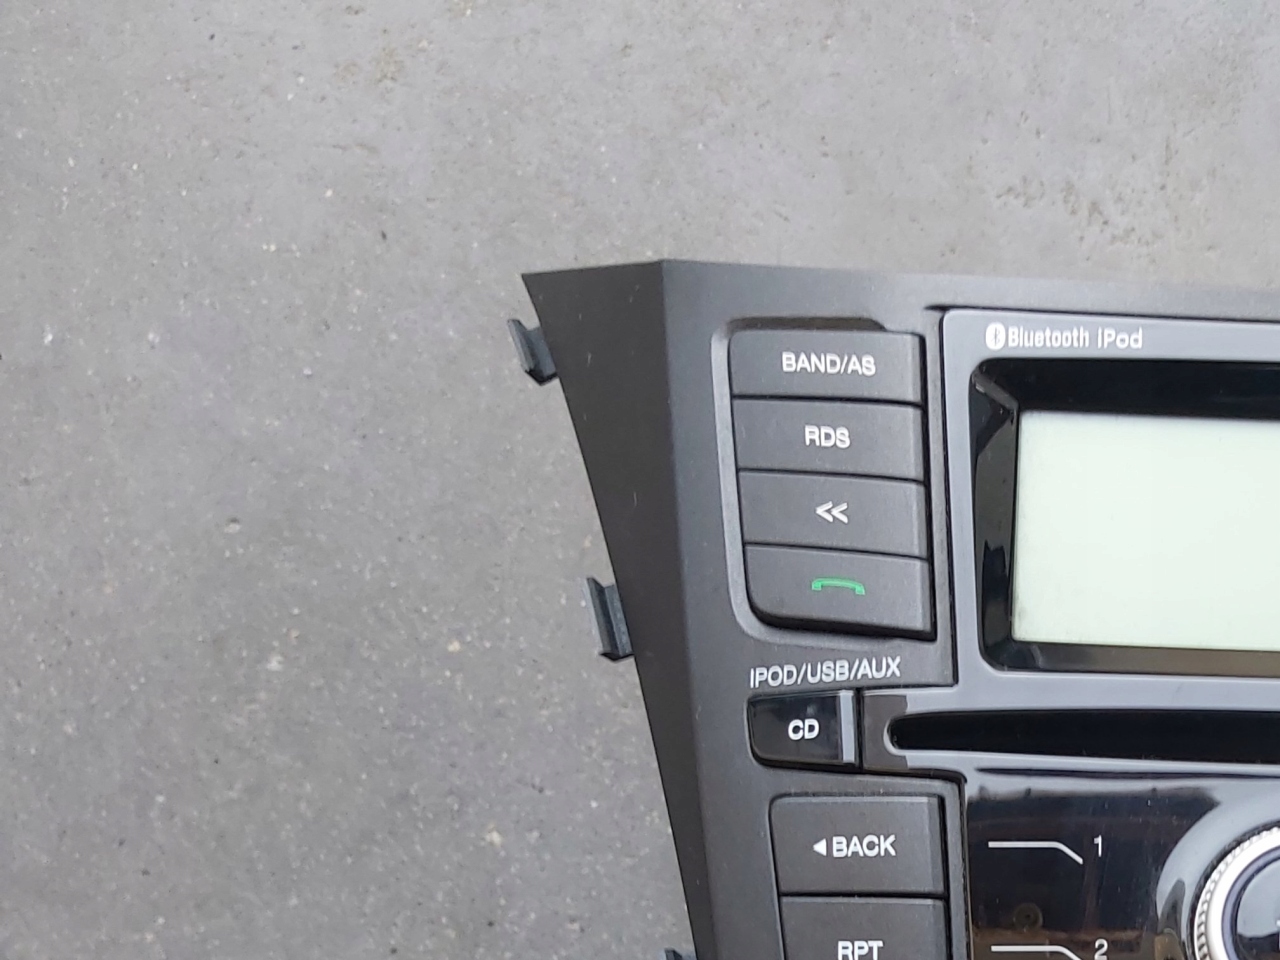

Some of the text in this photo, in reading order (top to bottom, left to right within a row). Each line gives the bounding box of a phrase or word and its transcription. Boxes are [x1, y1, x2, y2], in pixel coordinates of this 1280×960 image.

[1008, 325, 1090, 348] Bluetooth
[782, 351, 876, 376] BAND/AS
[804, 425, 851, 449] RDS
[750, 657, 901, 689] IPOD/USB/AUX
[787, 718, 820, 741] CD
[832, 834, 896, 858] BACK
[1094, 835, 1102, 857] 1
[1094, 938, 1108, 960] 2
